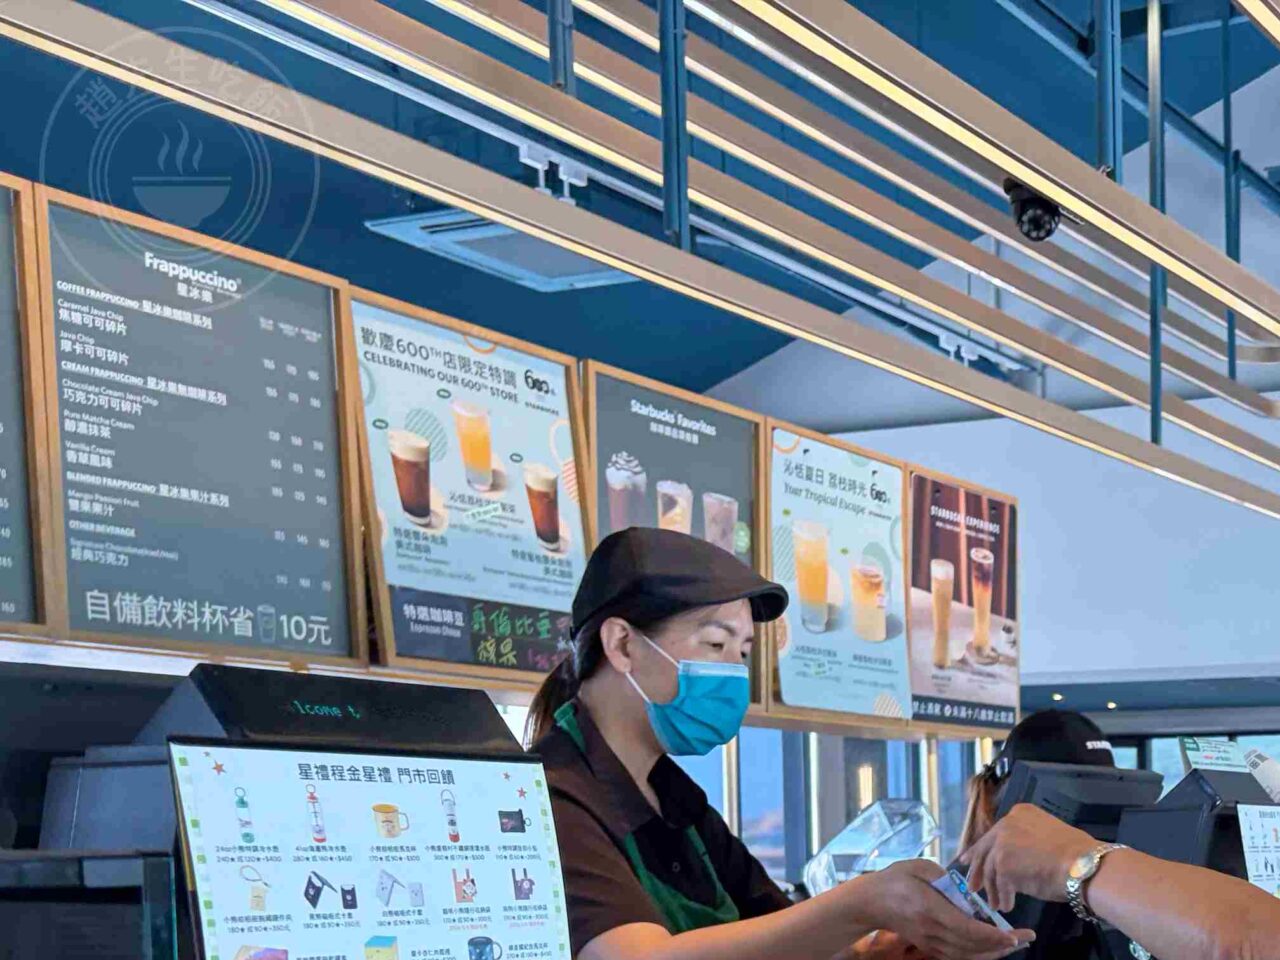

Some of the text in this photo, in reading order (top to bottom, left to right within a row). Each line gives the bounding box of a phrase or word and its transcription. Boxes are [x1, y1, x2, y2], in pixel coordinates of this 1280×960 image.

[144, 251, 238, 292] Frappuccino
[56, 280, 85, 295] COFFEE
[177, 282, 213, 303] 星冰樂
[58, 298, 124, 322] Caramel Java Chip
[58, 308, 128, 336] 焦糖可可碎片
[60, 330, 95, 345] Java Chip
[60, 339, 129, 366] 摩卡可可碎片
[62, 378, 99, 394] Chocolate
[101, 387, 125, 398] Cream
[364, 350, 436, 379] CELEBRATING
[437, 371, 460, 387] OUR
[490, 385, 519, 404] STORE
[63, 389, 143, 416] 巧克力可可碎片
[82, 413, 110, 425] Matcha
[110, 419, 135, 430] Cream
[630, 399, 676, 425] Starbucks
[677, 413, 717, 437] Favorites
[65, 440, 115, 456] Vanilla Cream
[66, 450, 113, 469] 香草風味
[66, 470, 102, 485] BLENDED
[784, 459, 824, 485] 沁恬夏日
[784, 481, 867, 516] Your Tropical Escape
[71, 547, 128, 567] 經典巧克力
[86, 589, 332, 646] 自備飲料杯省 10元
[298, 763, 455, 785] 星禮程金星禮 門市回饋
